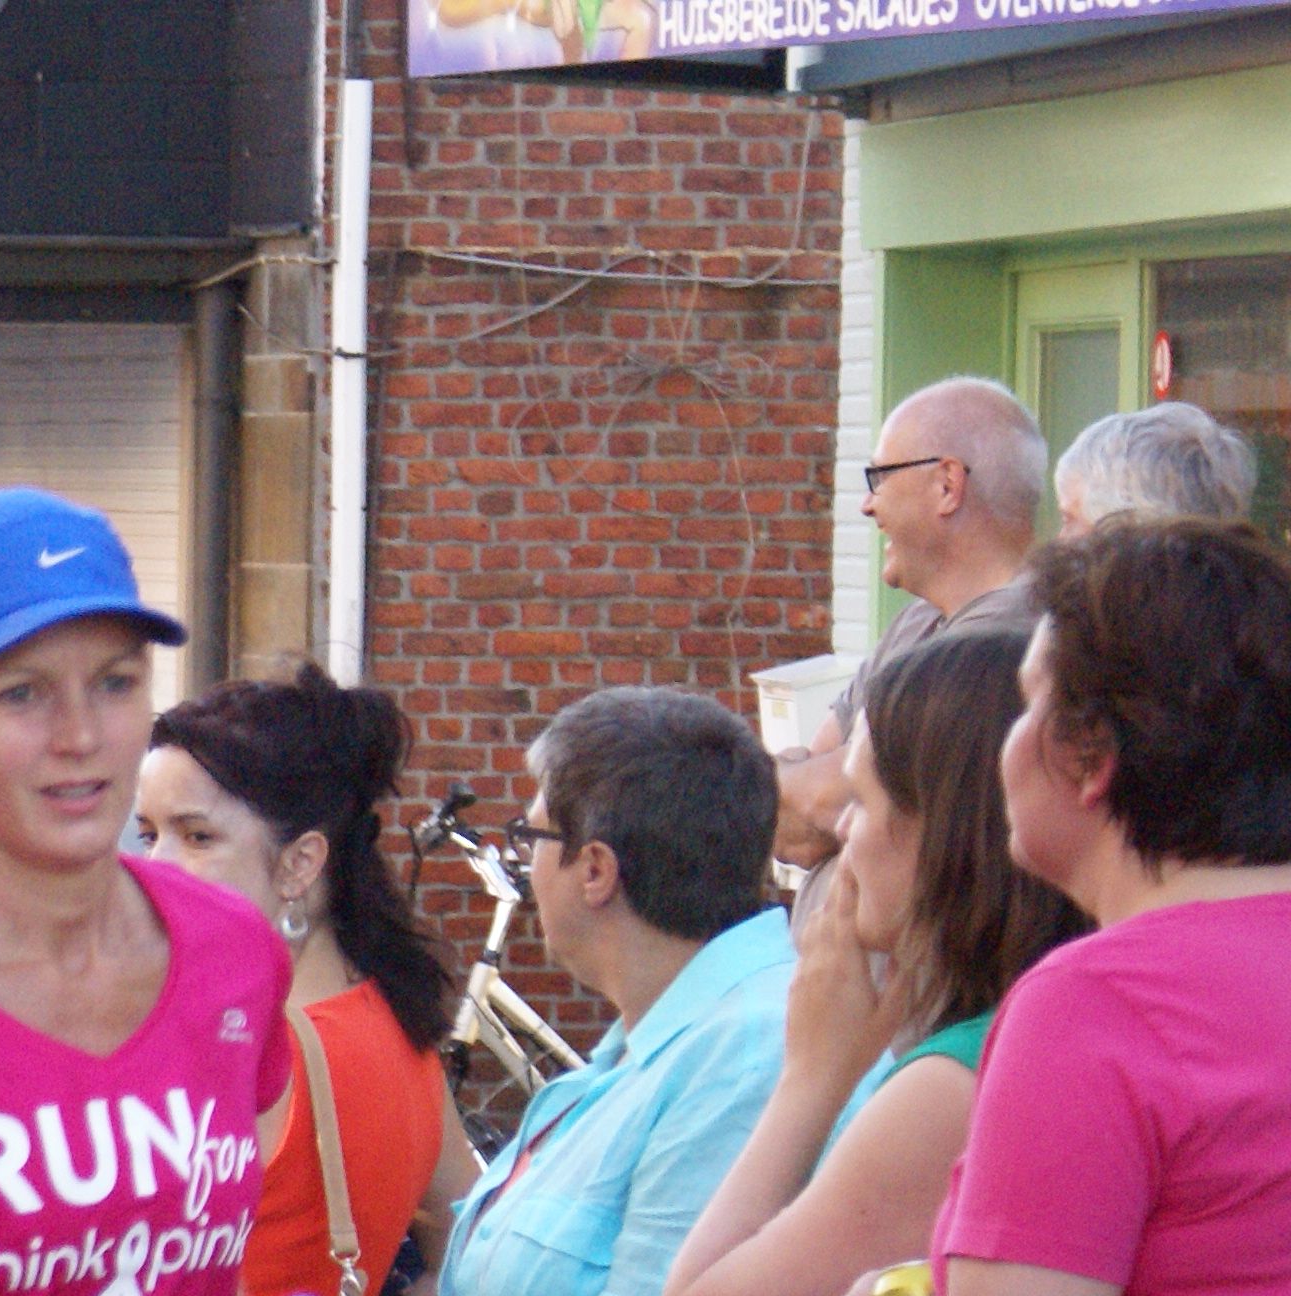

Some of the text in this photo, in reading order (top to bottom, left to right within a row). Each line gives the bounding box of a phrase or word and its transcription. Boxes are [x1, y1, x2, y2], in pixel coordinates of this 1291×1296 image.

[658, 0, 831, 49] HUISBEREIDE
[185, 1098, 257, 1222] for
[145, 1208, 254, 1293] pink
